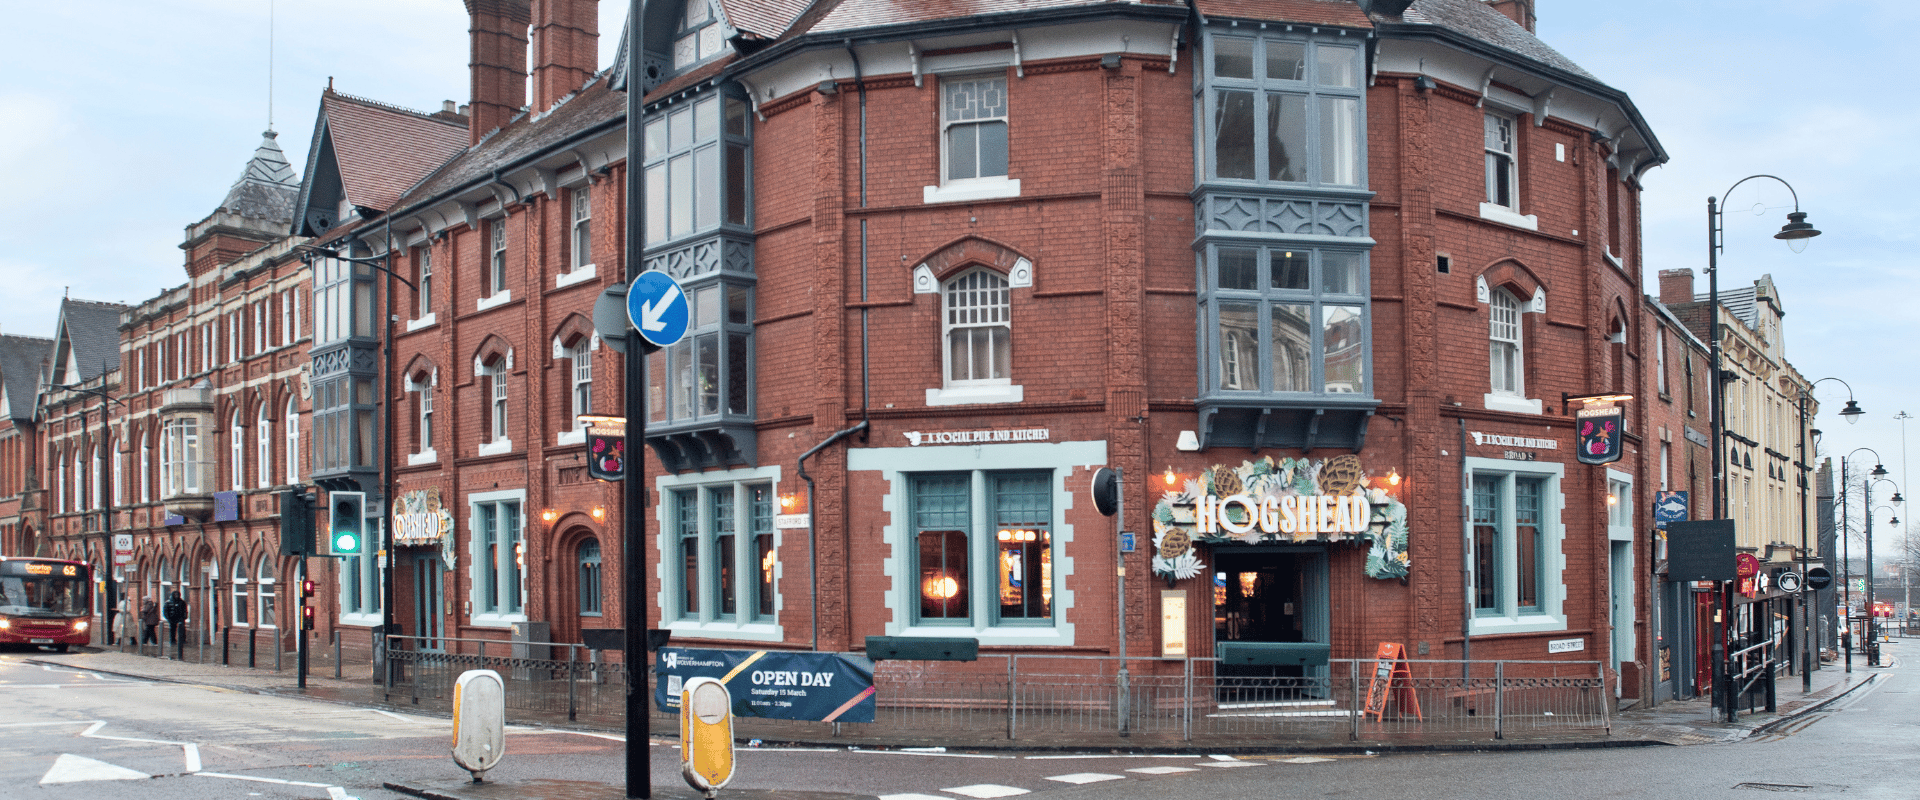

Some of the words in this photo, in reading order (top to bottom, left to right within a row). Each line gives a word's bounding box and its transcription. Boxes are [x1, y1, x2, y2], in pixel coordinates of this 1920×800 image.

[1579, 408, 1620, 416] HOGSHEAD
[590, 428, 625, 436] HOGSHEA
[928, 433, 934, 443] A
[936, 431, 970, 443] SOCIAL
[973, 430, 991, 442] PUB
[994, 430, 1010, 441] AND
[1013, 429, 1049, 441] KITCHEN
[1486, 434, 1491, 444] A
[1491, 434, 1514, 446] SOCIAL
[1514, 436, 1525, 447] PUB
[1526, 437, 1536, 448] AND
[1537, 438, 1557, 449] KITCHEN
[1504, 450, 1527, 460] BROAD
[1196, 494, 1371, 534] HOGSHEAD
[393, 513, 439, 539] OGSHEAD
[778, 517, 801, 526] STAFFORD
[63, 565, 76, 576] 62
[1567, 640, 1583, 649] STREET
[751, 670, 798, 686] OPEN
[801, 671, 834, 687] DAY
[751, 688, 778, 697] Saturday
[787, 689, 807, 697] March
